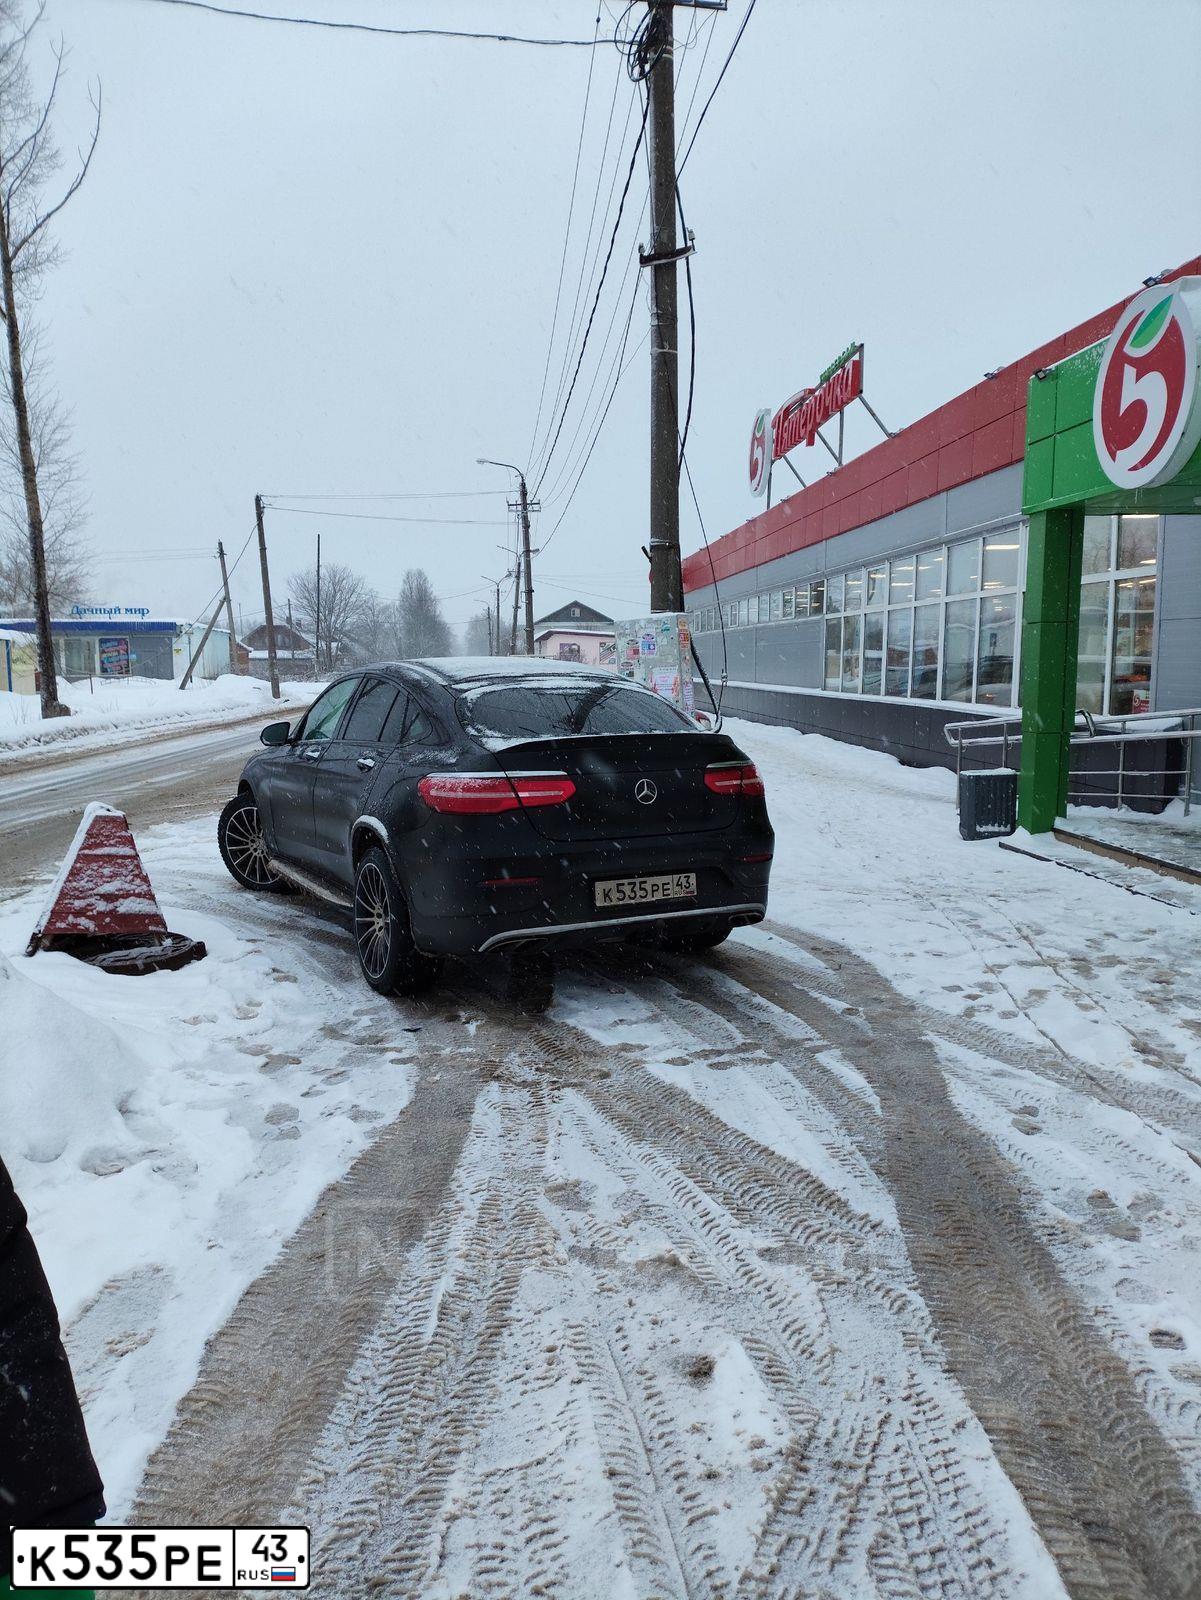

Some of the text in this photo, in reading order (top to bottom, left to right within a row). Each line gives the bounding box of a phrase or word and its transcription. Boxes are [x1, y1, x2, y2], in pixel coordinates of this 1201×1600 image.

[1114, 363, 1168, 473] 5
[71, 605, 150, 617] Дачный мир
[675, 875, 691, 889] 43
